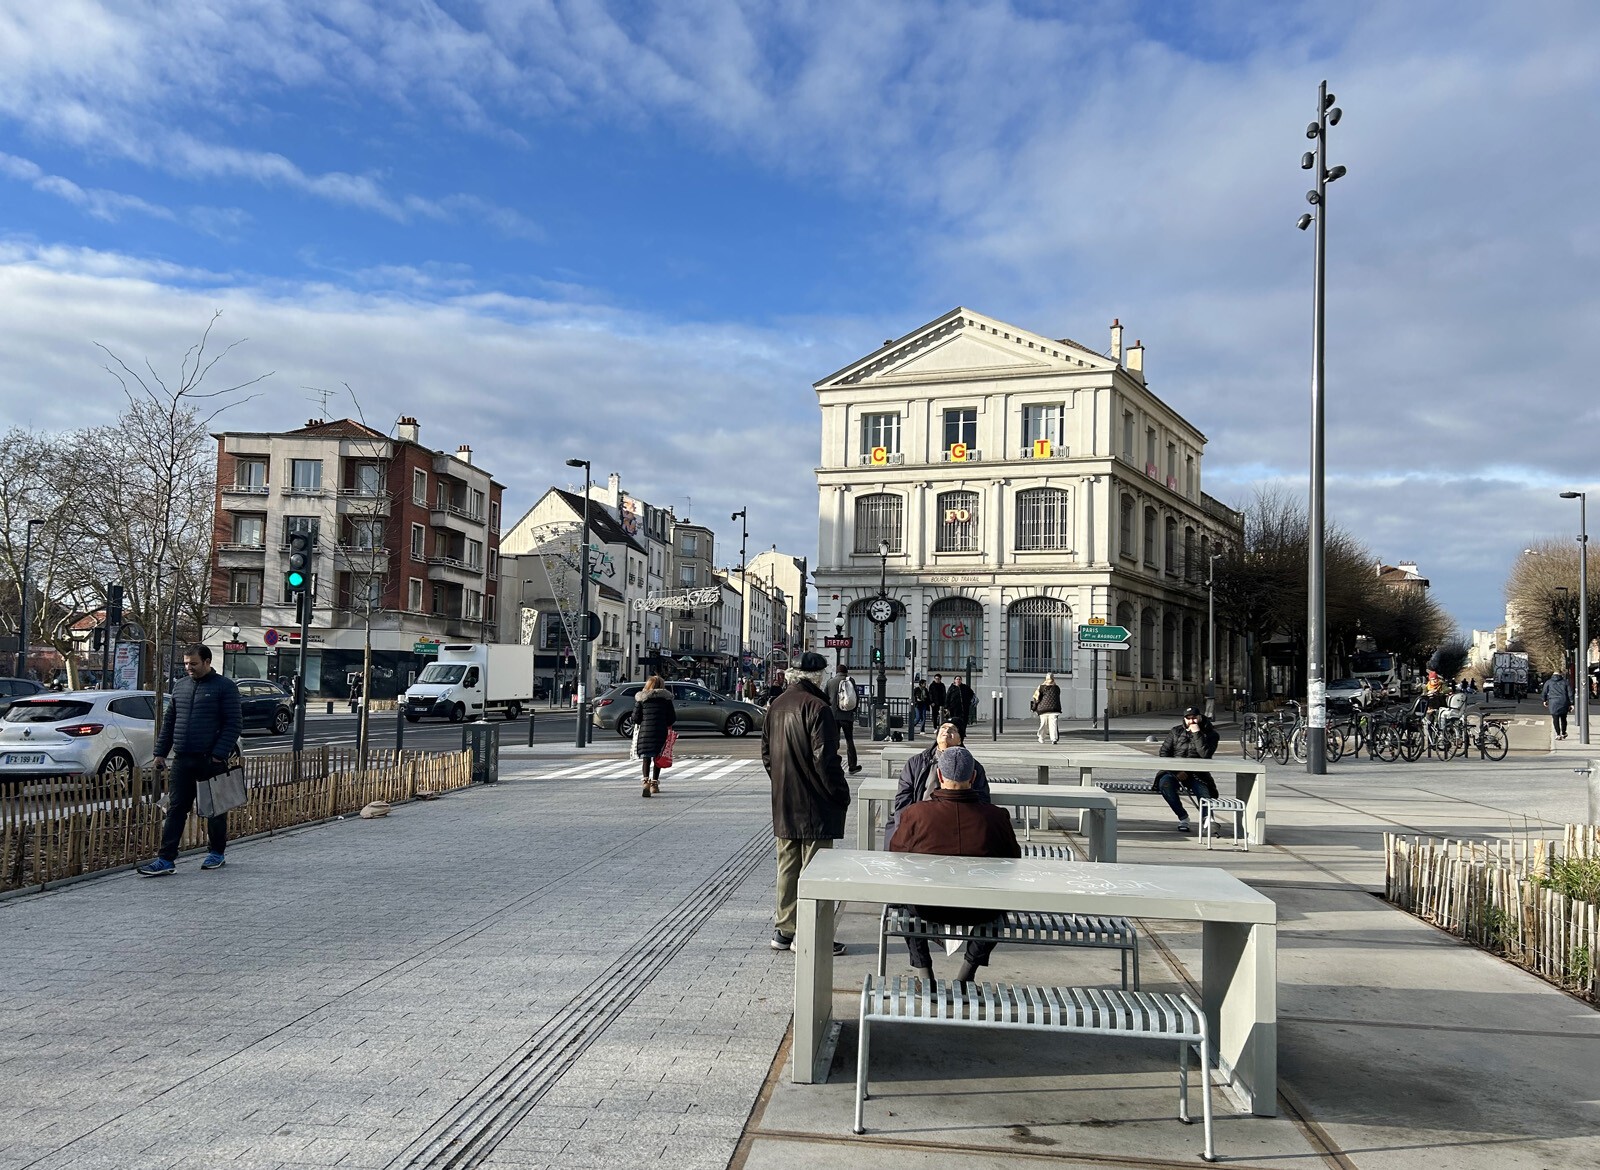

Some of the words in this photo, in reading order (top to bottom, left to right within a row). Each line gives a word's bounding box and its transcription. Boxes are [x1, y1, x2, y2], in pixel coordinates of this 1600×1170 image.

[873, 447, 885, 462] C
[952, 444, 965, 459] G
[1036, 440, 1048, 455] T
[945, 509, 971, 524] FO
